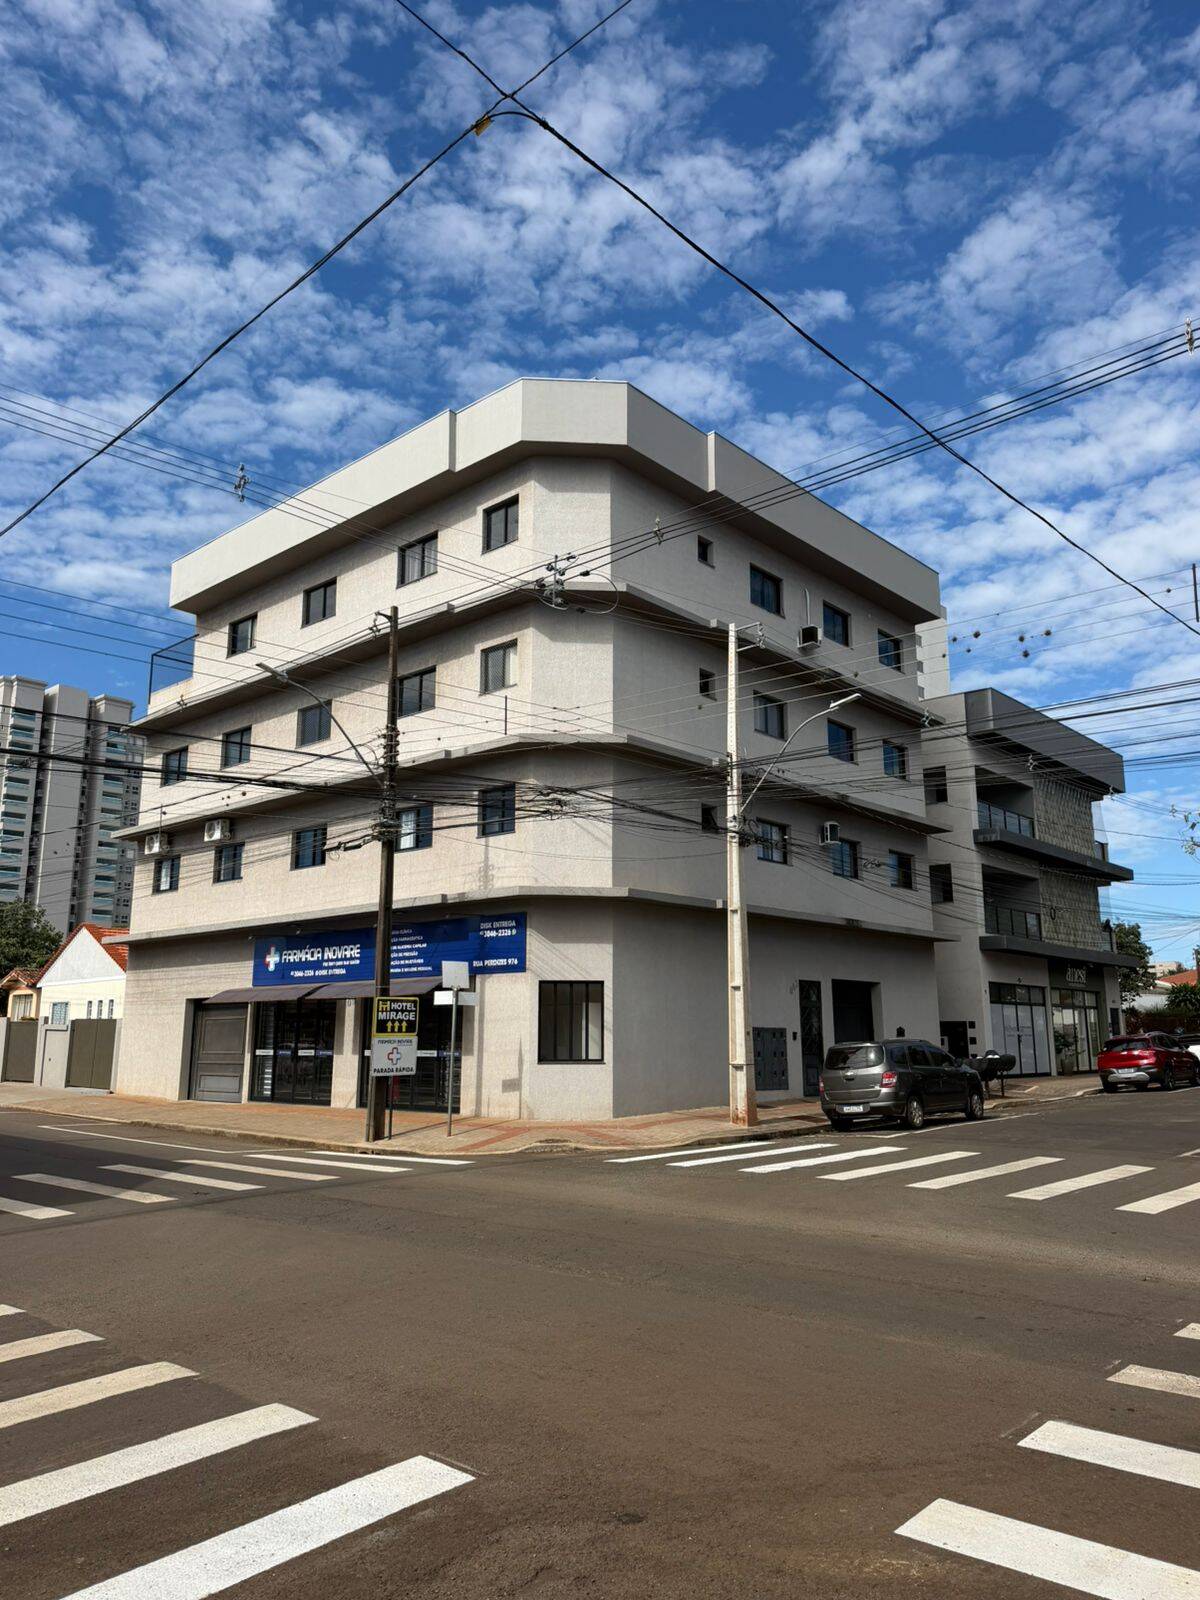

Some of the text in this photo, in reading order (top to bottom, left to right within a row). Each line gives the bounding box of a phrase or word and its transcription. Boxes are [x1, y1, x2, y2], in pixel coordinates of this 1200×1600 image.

[493, 920, 516, 928] ENTREGA
[281, 945, 322, 963] FARMÁCIA
[323, 944, 361, 960] INOVARE
[391, 1002, 416, 1010] HOTEL
[378, 1011, 416, 1020] MIRAGE
